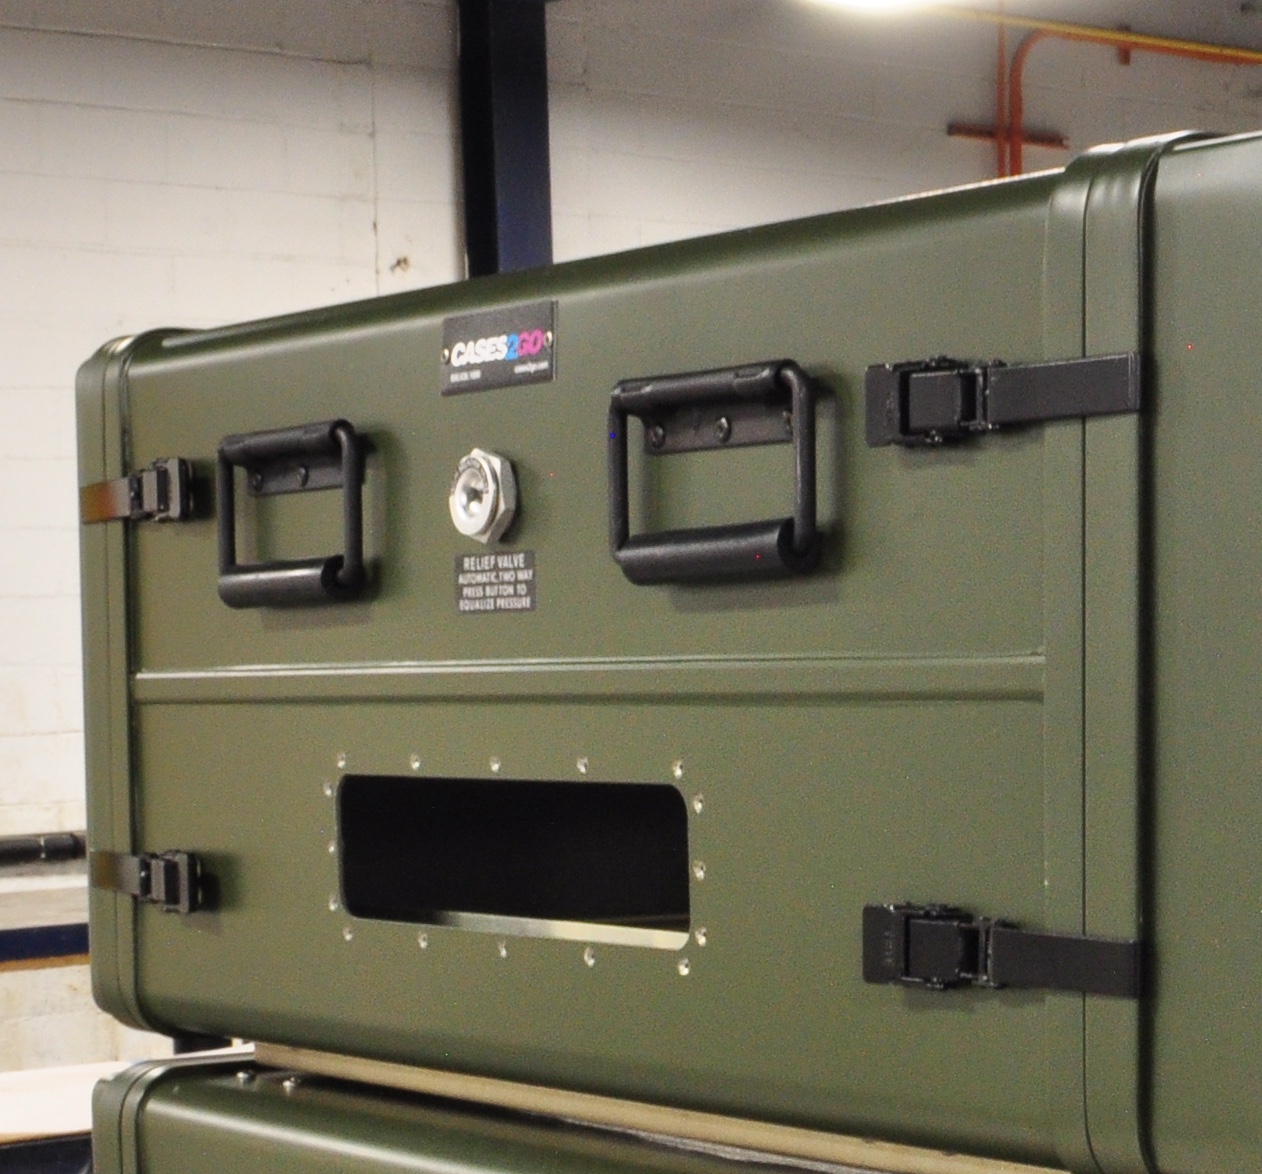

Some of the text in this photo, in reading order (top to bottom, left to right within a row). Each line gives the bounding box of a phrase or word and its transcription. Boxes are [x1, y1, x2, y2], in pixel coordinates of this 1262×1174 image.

[451, 329, 544, 367] CASES2GO
[463, 553, 525, 571] RELIEF VALVE
[499, 570, 515, 583] TWO
[516, 569, 534, 581] WAY
[462, 583, 527, 598] PRESS BUTTON TO
[459, 596, 531, 611] EQUALIZE PRESSURE
